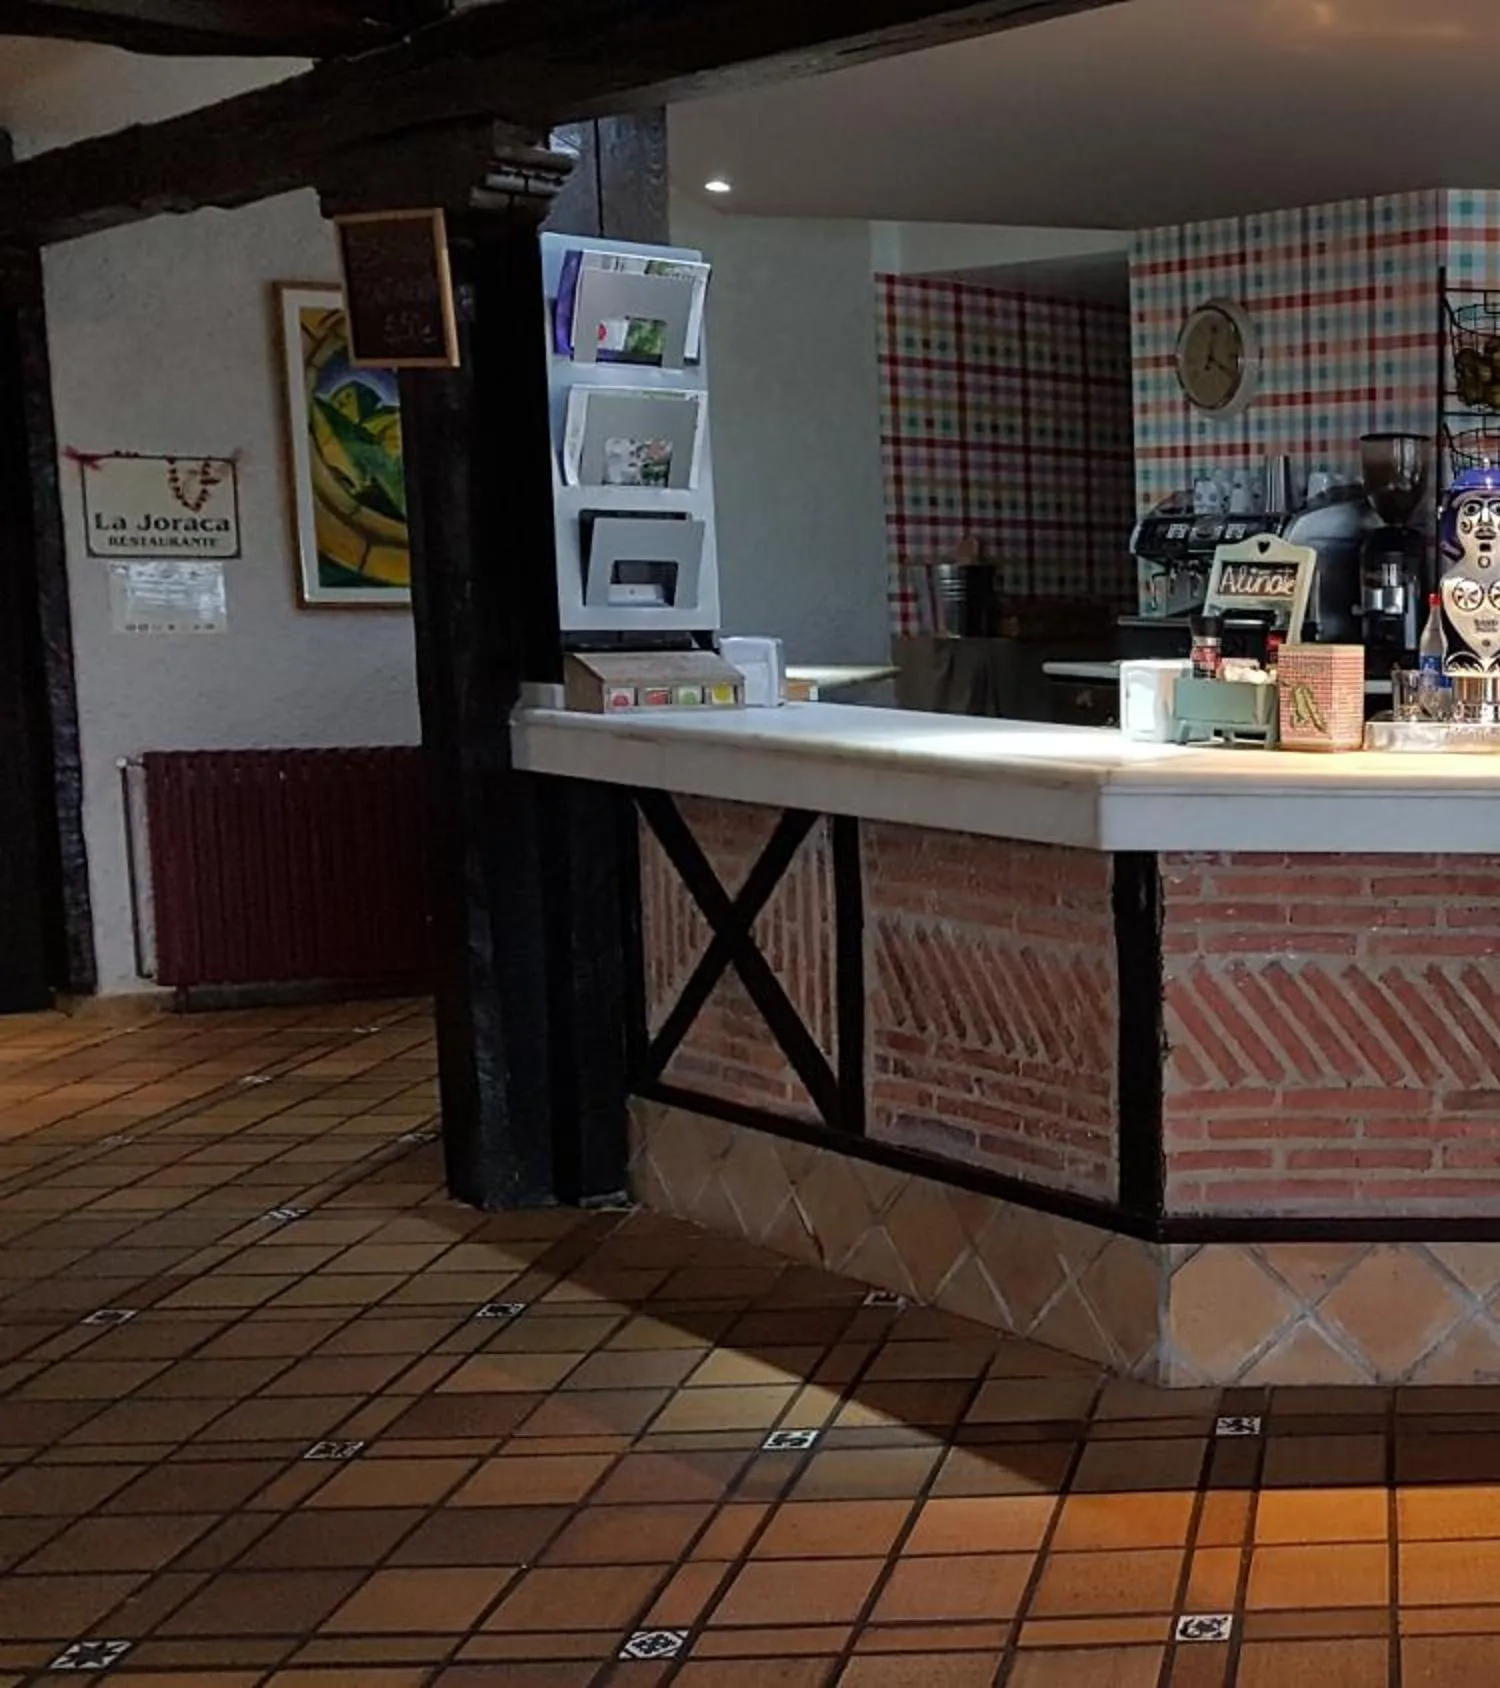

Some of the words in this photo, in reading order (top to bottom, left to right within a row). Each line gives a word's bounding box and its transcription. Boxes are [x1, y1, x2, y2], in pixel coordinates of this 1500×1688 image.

[95, 511, 127, 531] La
[137, 513, 230, 532] Joraca
[108, 536, 218, 547] RESTAURANTE
